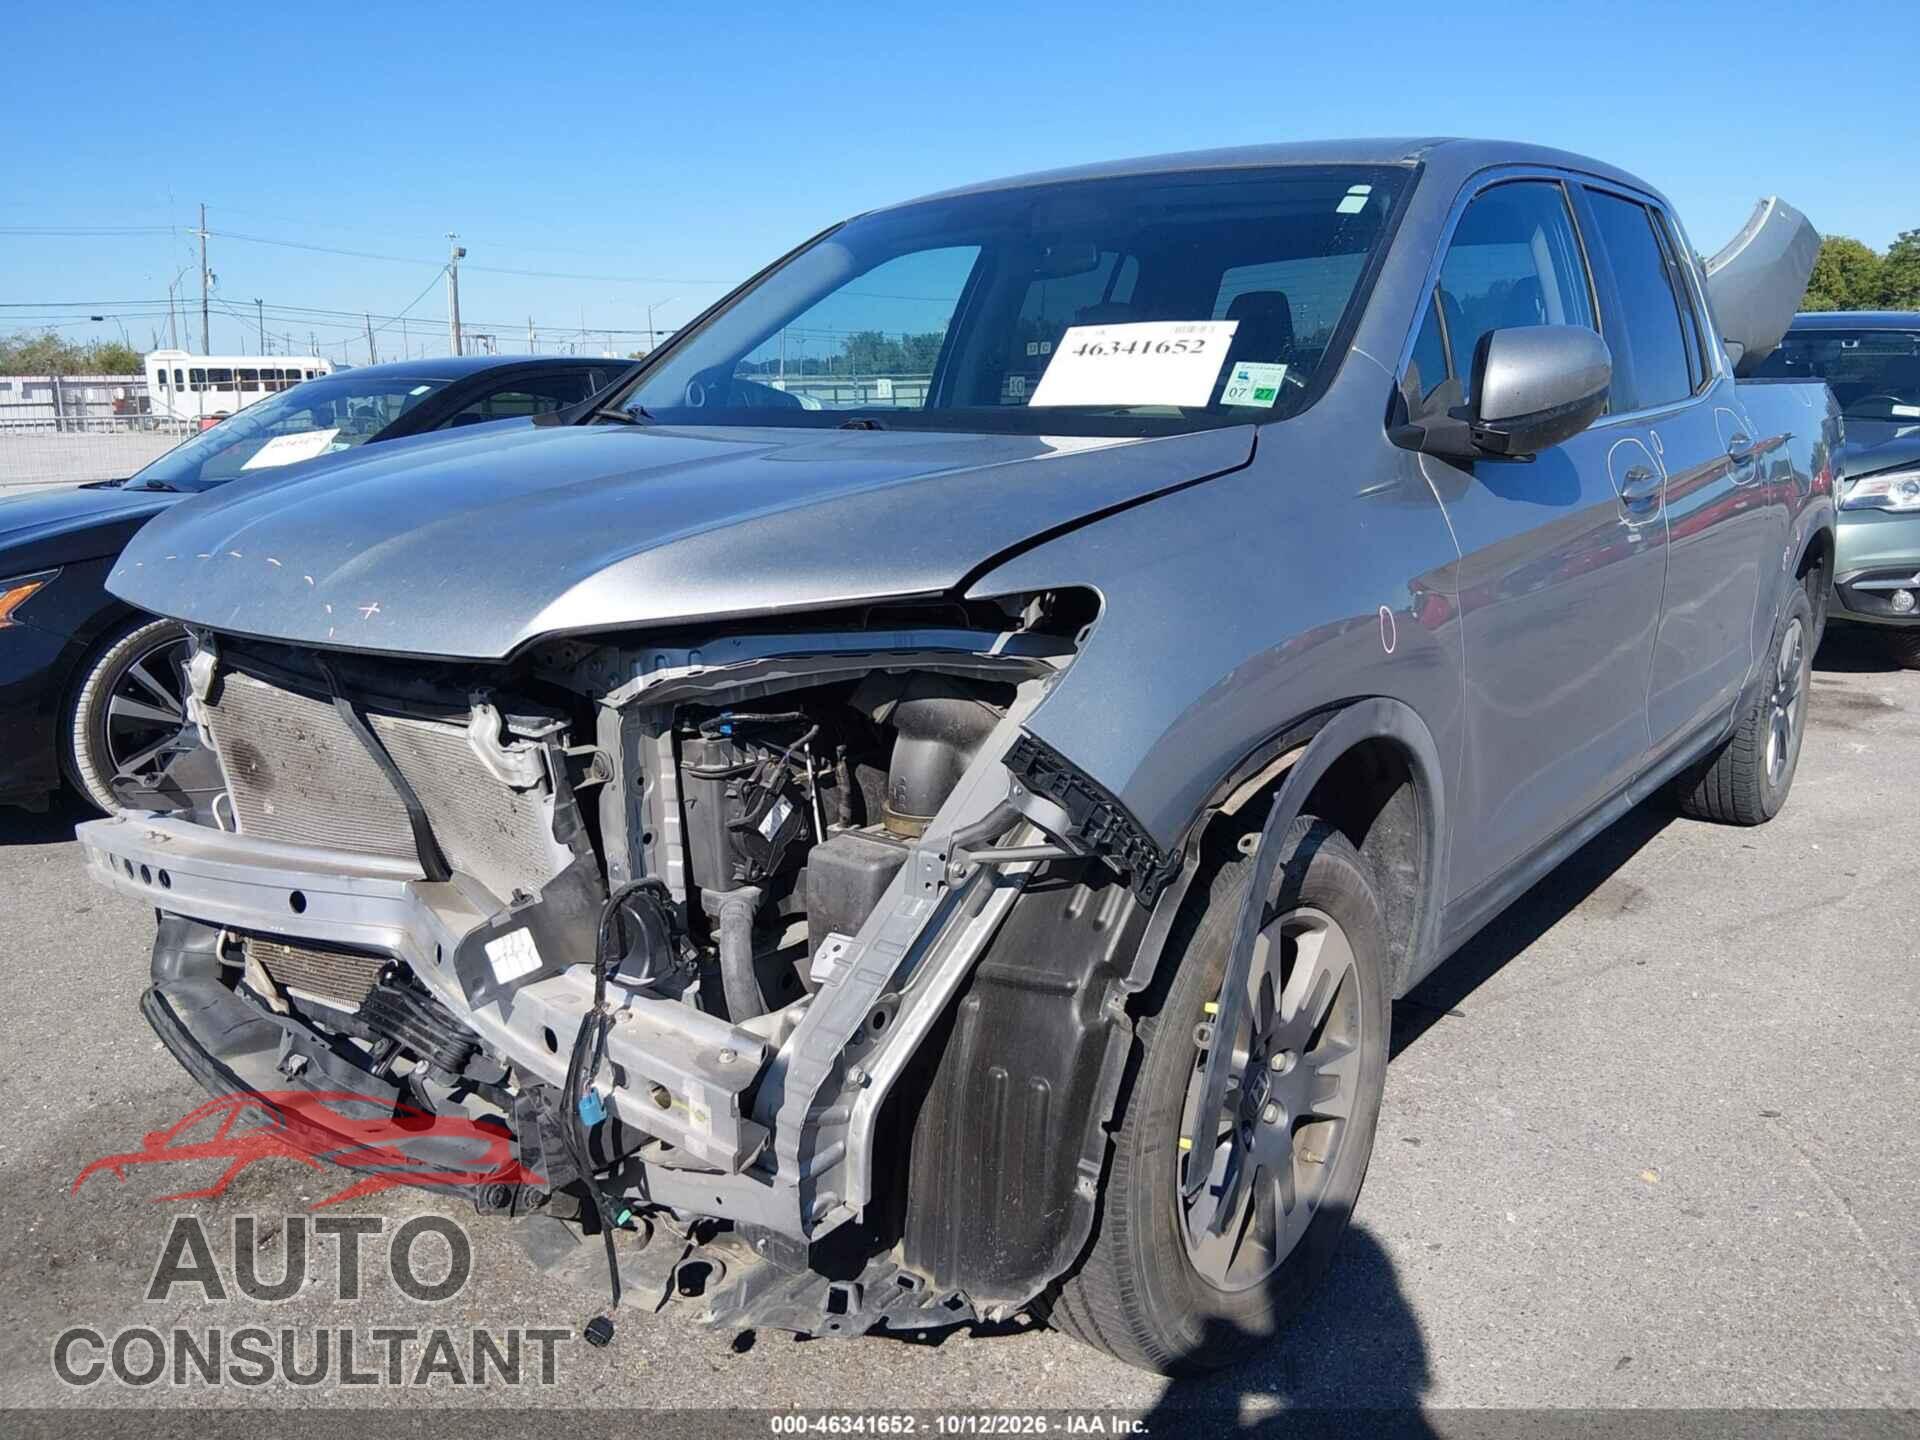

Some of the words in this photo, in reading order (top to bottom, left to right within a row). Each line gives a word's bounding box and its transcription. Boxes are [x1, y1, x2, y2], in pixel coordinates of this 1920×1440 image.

[1072, 339, 1206, 356] 46341652
[1228, 386, 1248, 399] 07
[1254, 388, 1273, 400] 27
